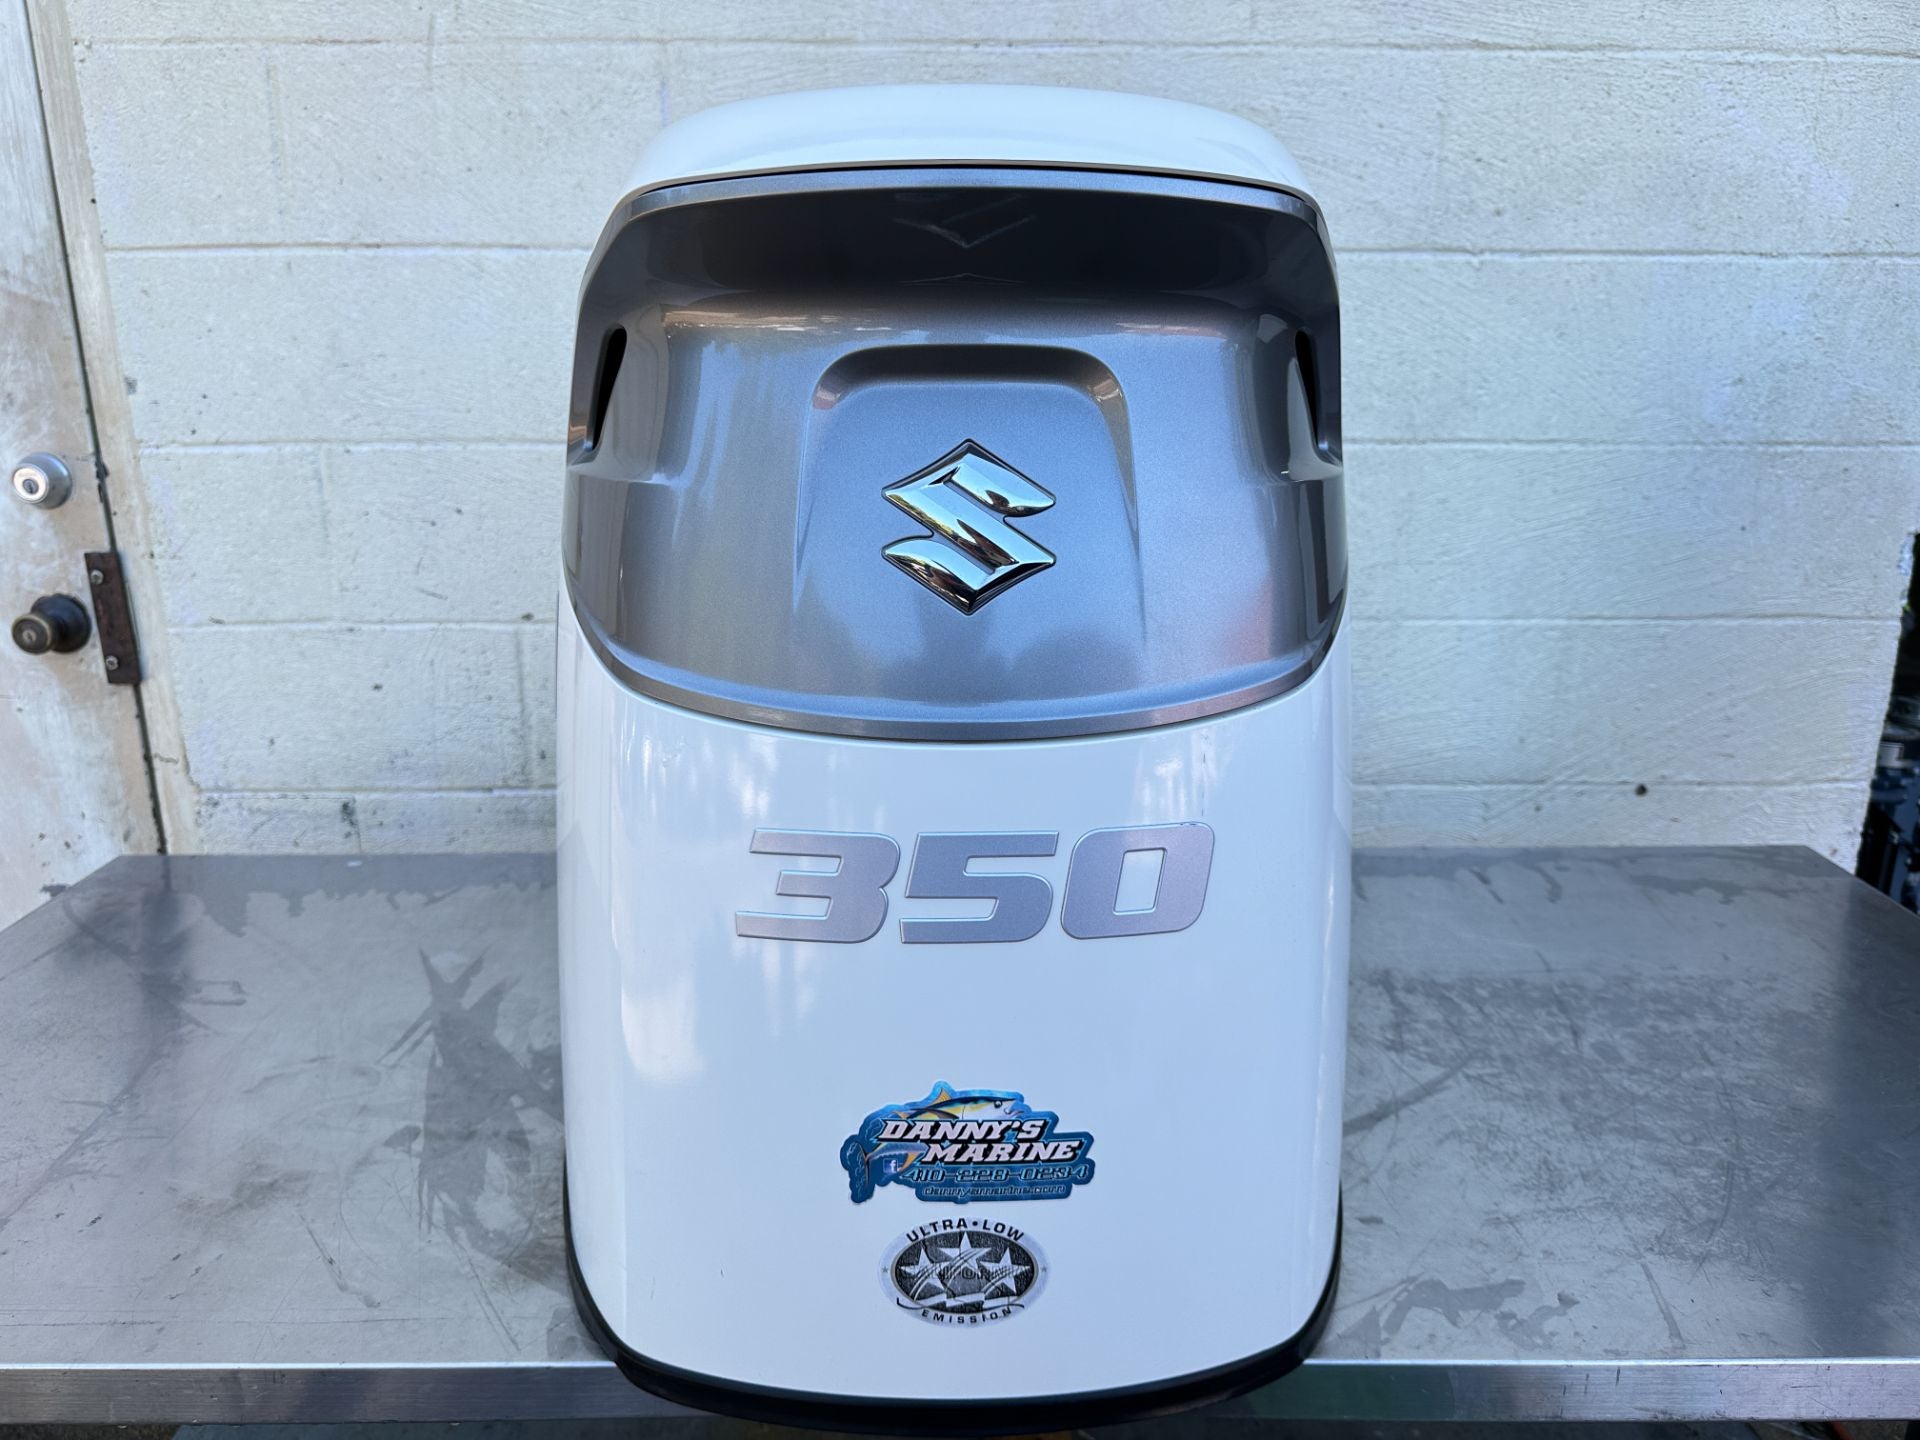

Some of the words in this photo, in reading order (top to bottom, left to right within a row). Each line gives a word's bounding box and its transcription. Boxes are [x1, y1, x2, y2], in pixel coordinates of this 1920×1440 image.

[735, 822, 1215, 943] 350
[878, 1119, 1046, 1141] DANNY'S
[921, 1140, 1082, 1163] MARINE
[921, 1305, 1012, 1324] EMISSION
